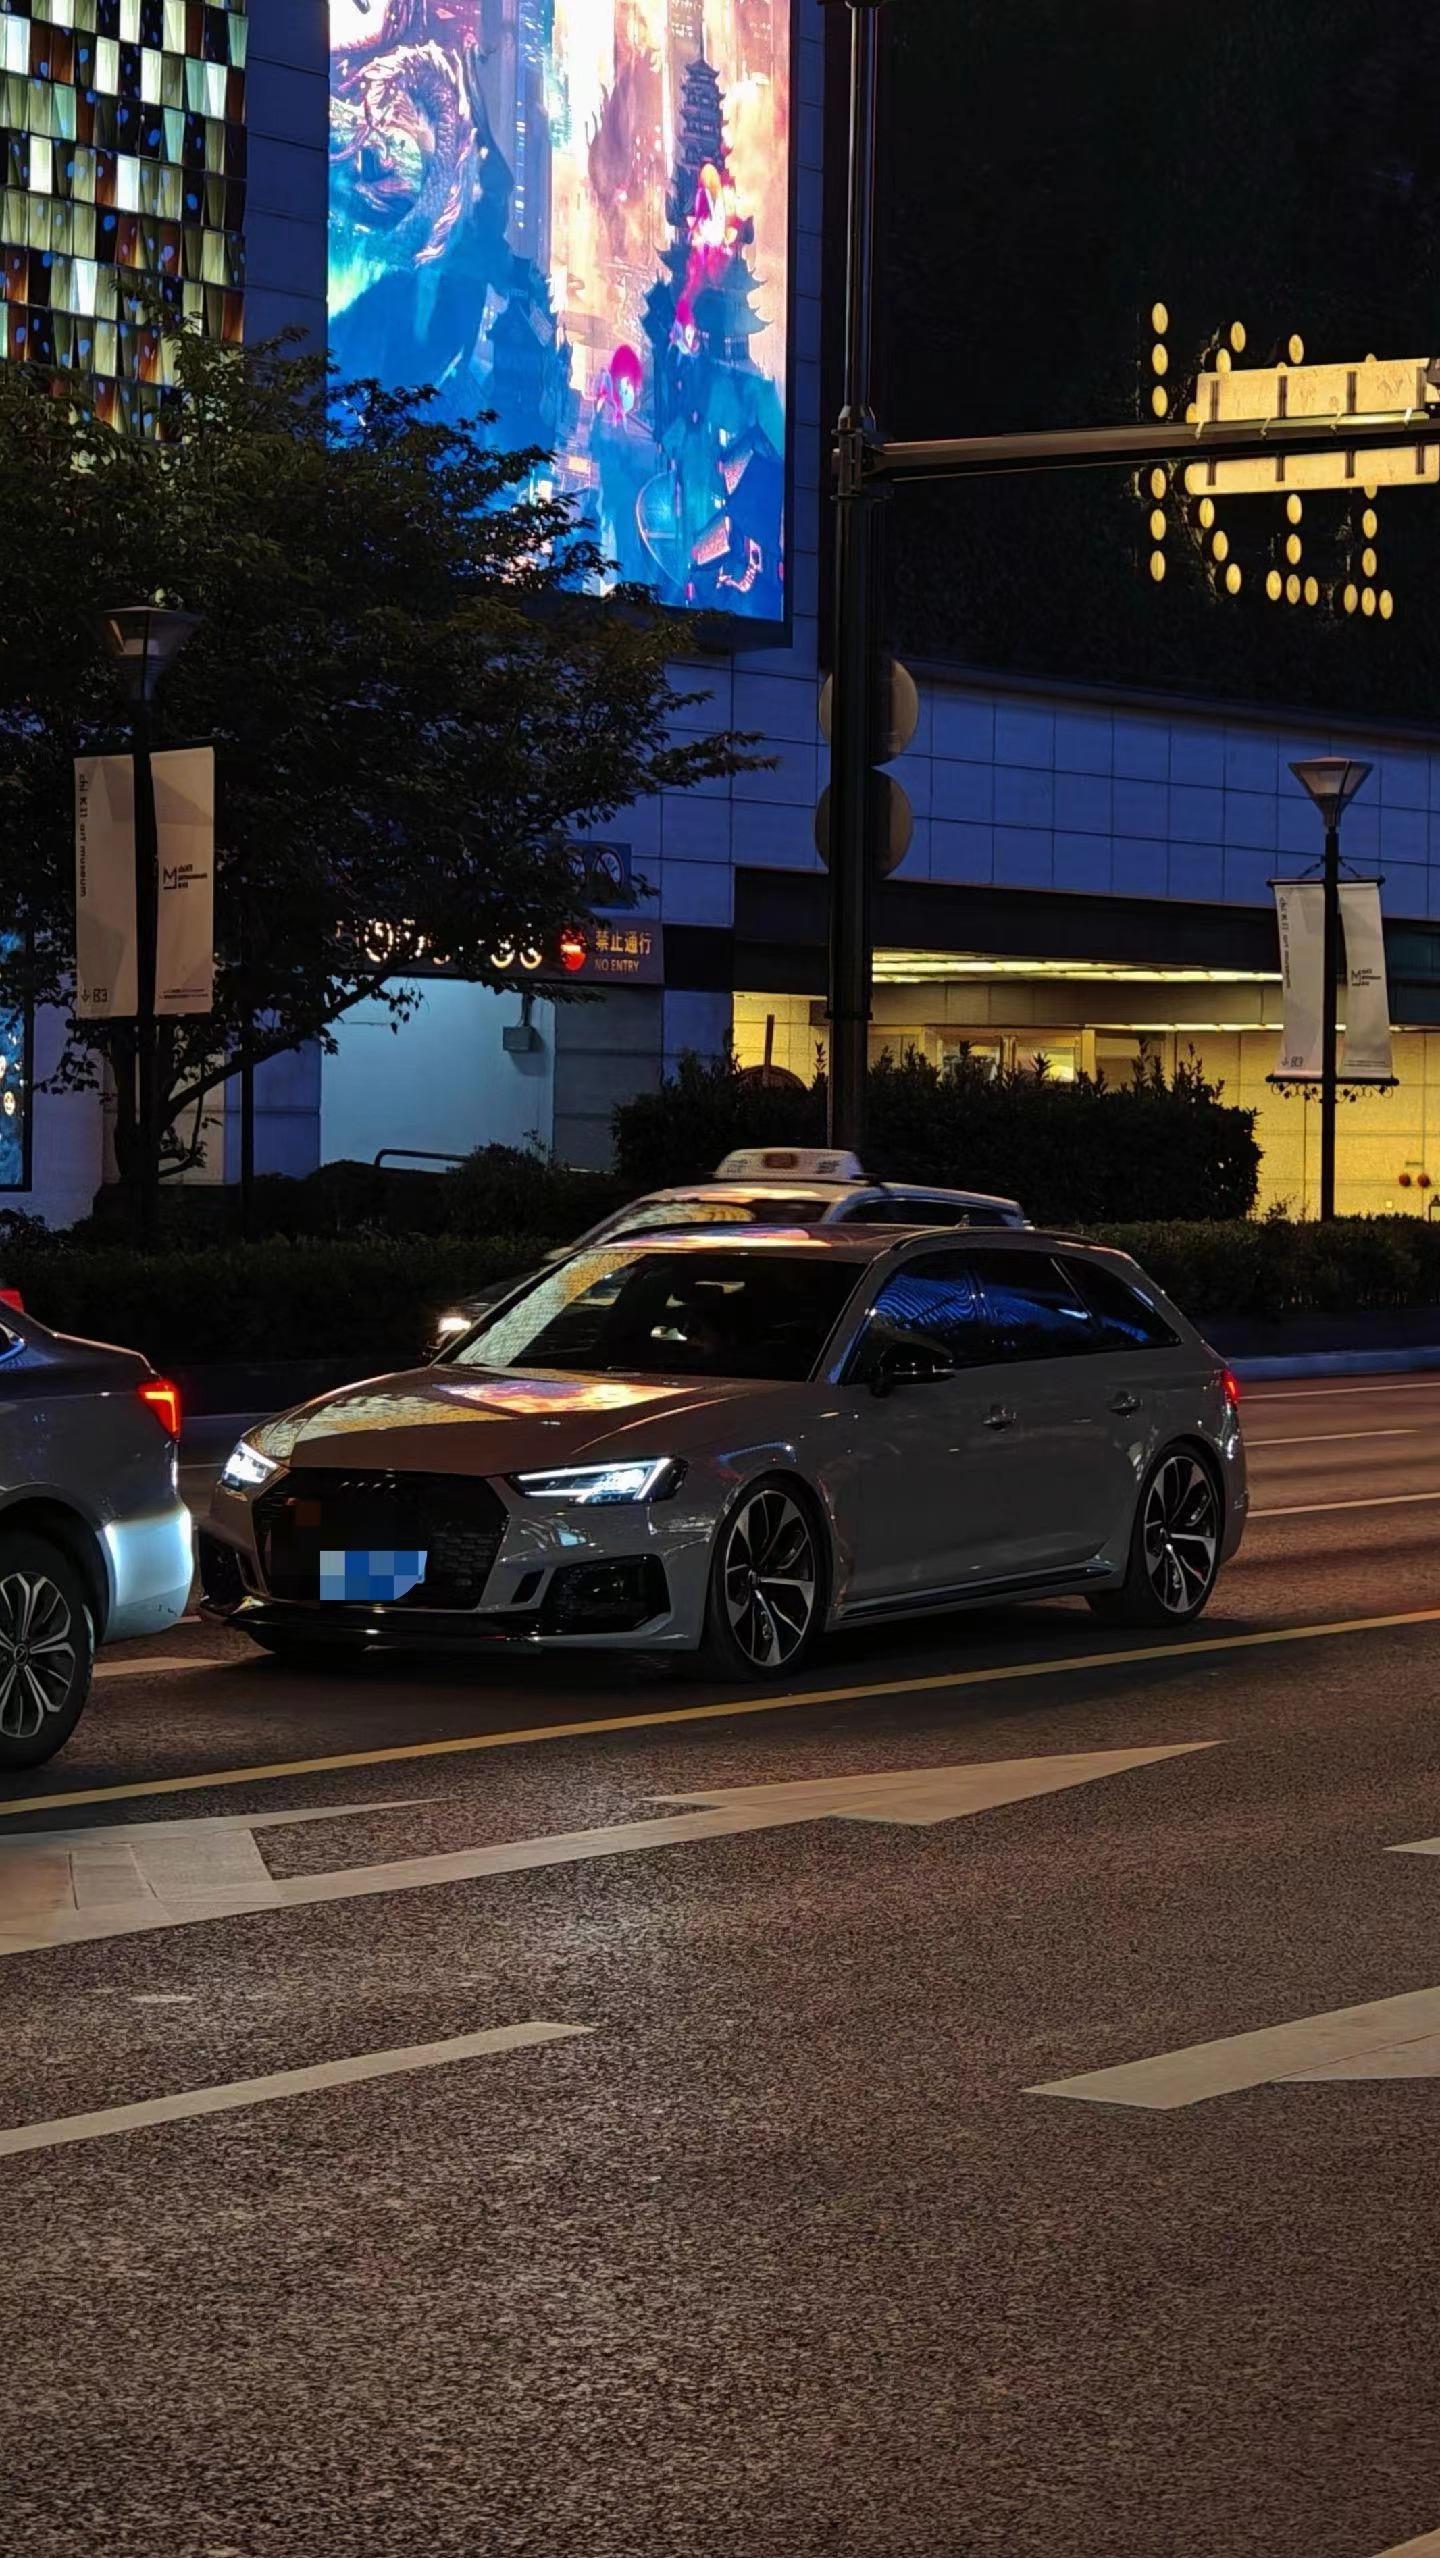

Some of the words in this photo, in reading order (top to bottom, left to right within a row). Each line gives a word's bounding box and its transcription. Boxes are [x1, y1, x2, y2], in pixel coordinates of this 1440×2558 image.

[79, 845, 88, 897] museum
[595, 930, 652, 955] 禁止通行
[595, 958, 609, 971] NO
[611, 959, 640, 972] ENTRY
